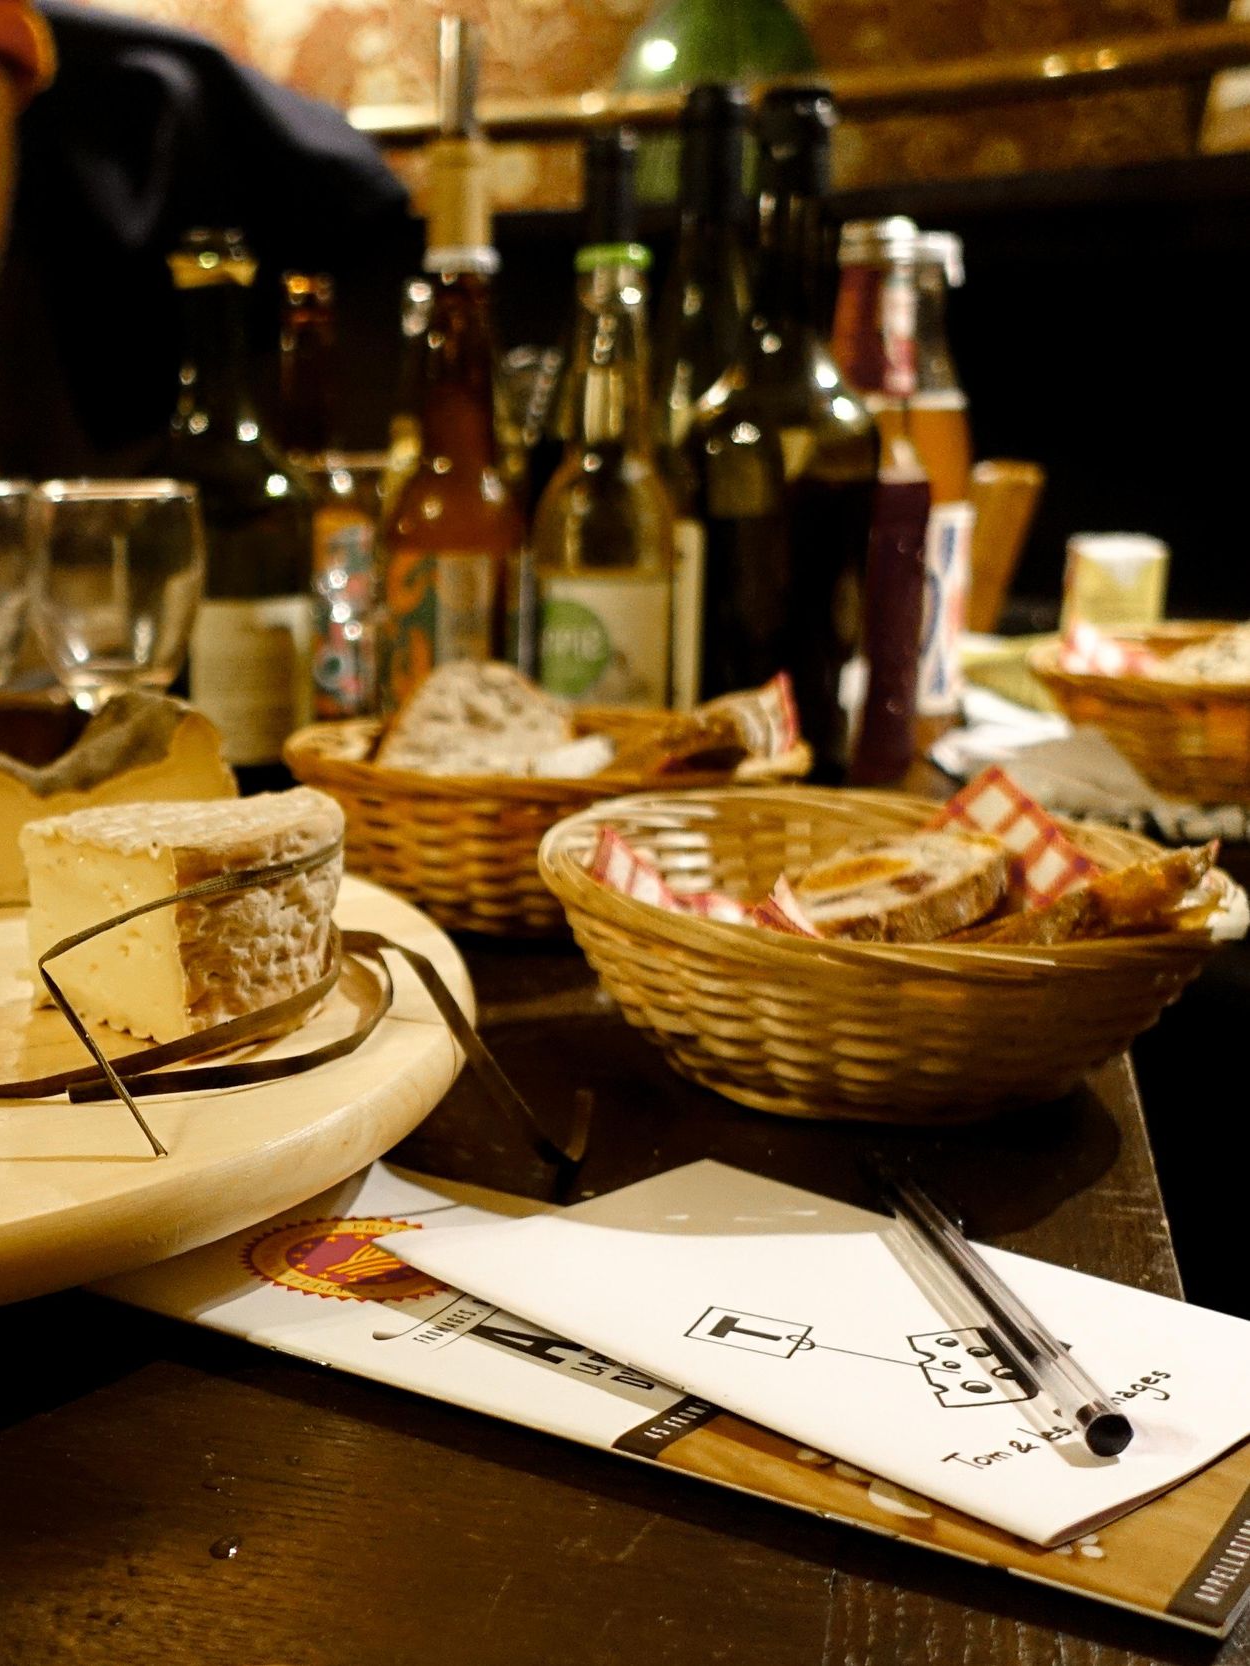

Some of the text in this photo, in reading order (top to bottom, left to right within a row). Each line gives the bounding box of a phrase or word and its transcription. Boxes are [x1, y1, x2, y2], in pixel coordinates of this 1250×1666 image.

[707, 1315, 782, 1341] T
[940, 1451, 1013, 1469] Tom
[1008, 1439, 1041, 1454] &
